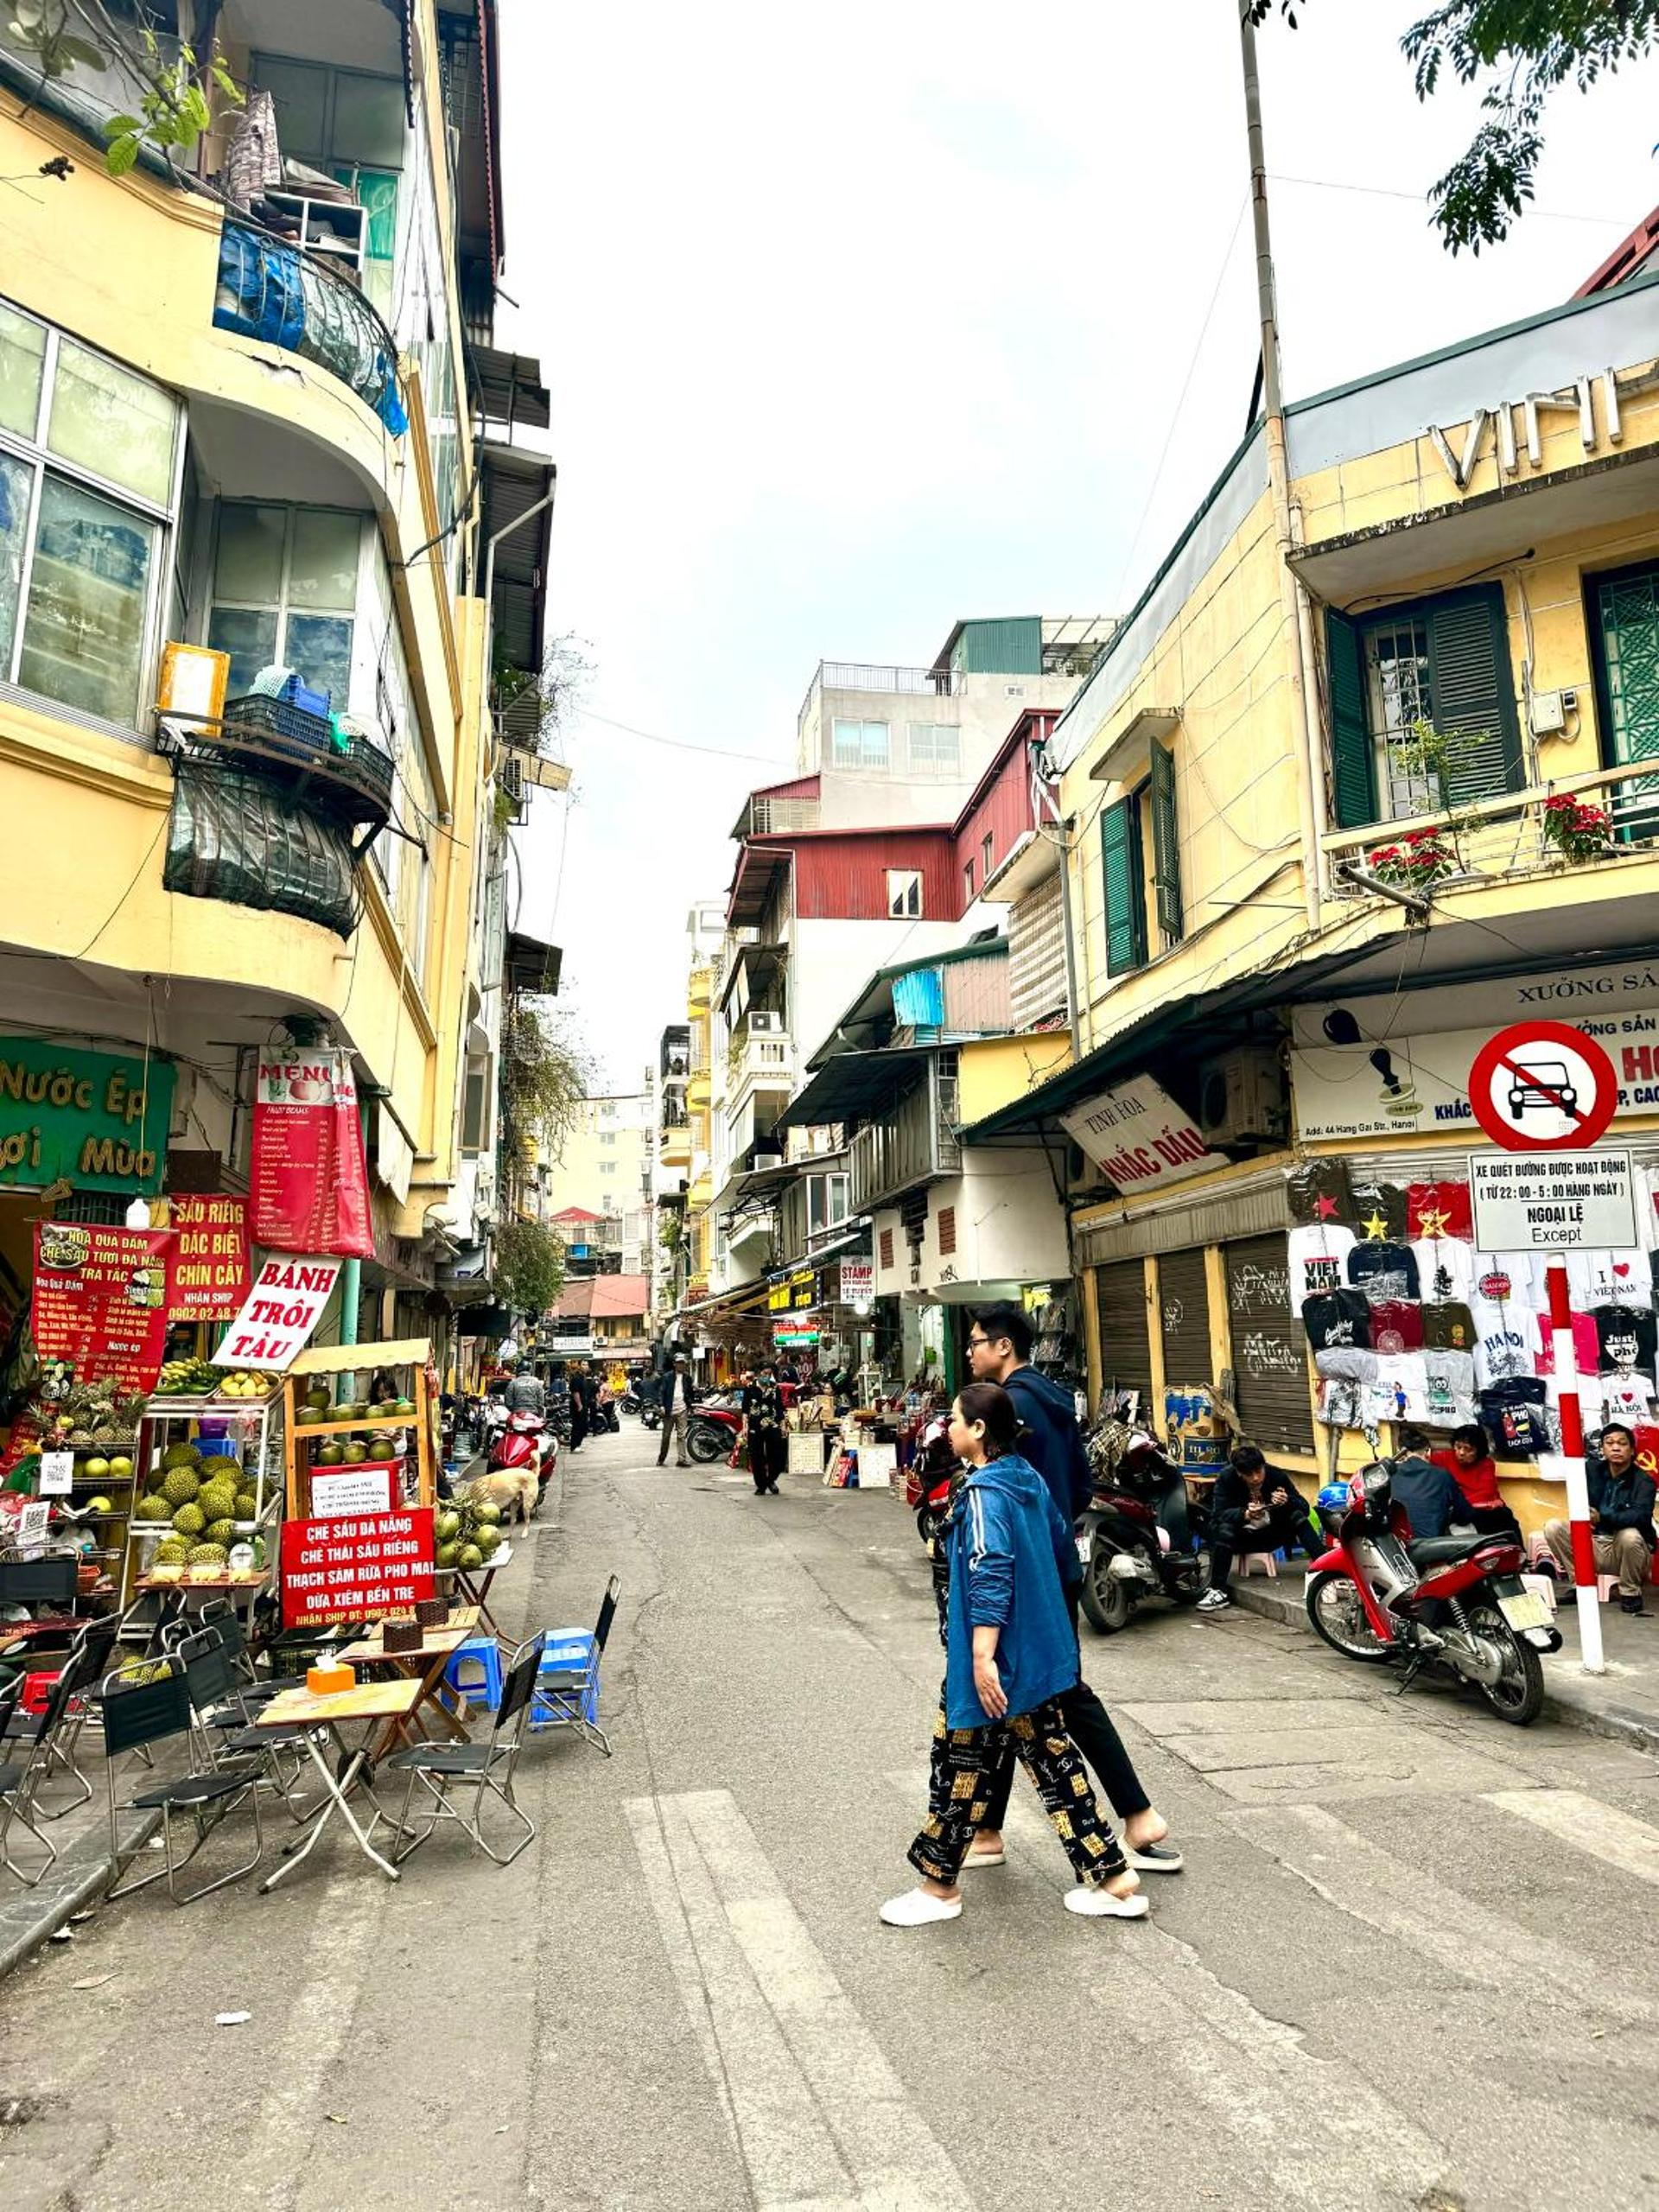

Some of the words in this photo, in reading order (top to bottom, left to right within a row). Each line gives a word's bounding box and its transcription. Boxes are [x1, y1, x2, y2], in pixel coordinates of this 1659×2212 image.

[1518, 976, 1614, 1003] XƯỞNG
[1576, 1020, 1617, 1036] ỞNG
[1622, 1014, 1656, 1033] SẢN
[1622, 1046, 1659, 1082] H
[106, 1067, 148, 1126] Ép
[1435, 1098, 1471, 1120] KHẮC
[0, 1126, 41, 1172] ơi
[81, 1136, 156, 1176] Mùa
[1100, 1143, 1162, 1185] KHẮC
[1151, 1124, 1211, 1167] DẤU
[1476, 1165, 1488, 1178] XE
[1491, 1160, 1513, 1177] QUÉT
[1516, 1160, 1547, 1177] ĐƯỜNG
[1549, 1161, 1573, 1179] ĐƯỢC
[1576, 1161, 1599, 1177] HOẠT
[1601, 1159, 1626, 1176] ĐỘNG
[1566, 1180, 1591, 1197] HÀNG
[1527, 1206, 1566, 1225] NGOẠI
[1569, 1203, 1585, 1224] LỆ
[180, 1230, 208, 1259] ĐẶC
[1531, 1226, 1582, 1244] Except
[176, 1261, 211, 1286] CHÍN
[217, 1261, 243, 1286] CÂY
[259, 1259, 336, 1293] BÁNH
[842, 1266, 873, 1280] STAMP
[1599, 1270, 1606, 1283] I
[249, 1299, 315, 1329] TRÔI
[232, 1332, 292, 1359] TÀU
[1484, 1331, 1524, 1353] HANOI
[307, 1523, 330, 1542] CHÈ
[301, 1546, 323, 1565] CHÈ
[327, 1545, 353, 1562] THÁI
[383, 1538, 419, 1556] RIÊNG
[287, 1571, 325, 1591] THẠCH
[411, 1560, 435, 1575] MAI
[334, 1588, 364, 1606] XIÊM
[366, 1584, 390, 1603] BẾN
[394, 1586, 415, 1599] TRE
[325, 1610, 346, 1624] SHIP
